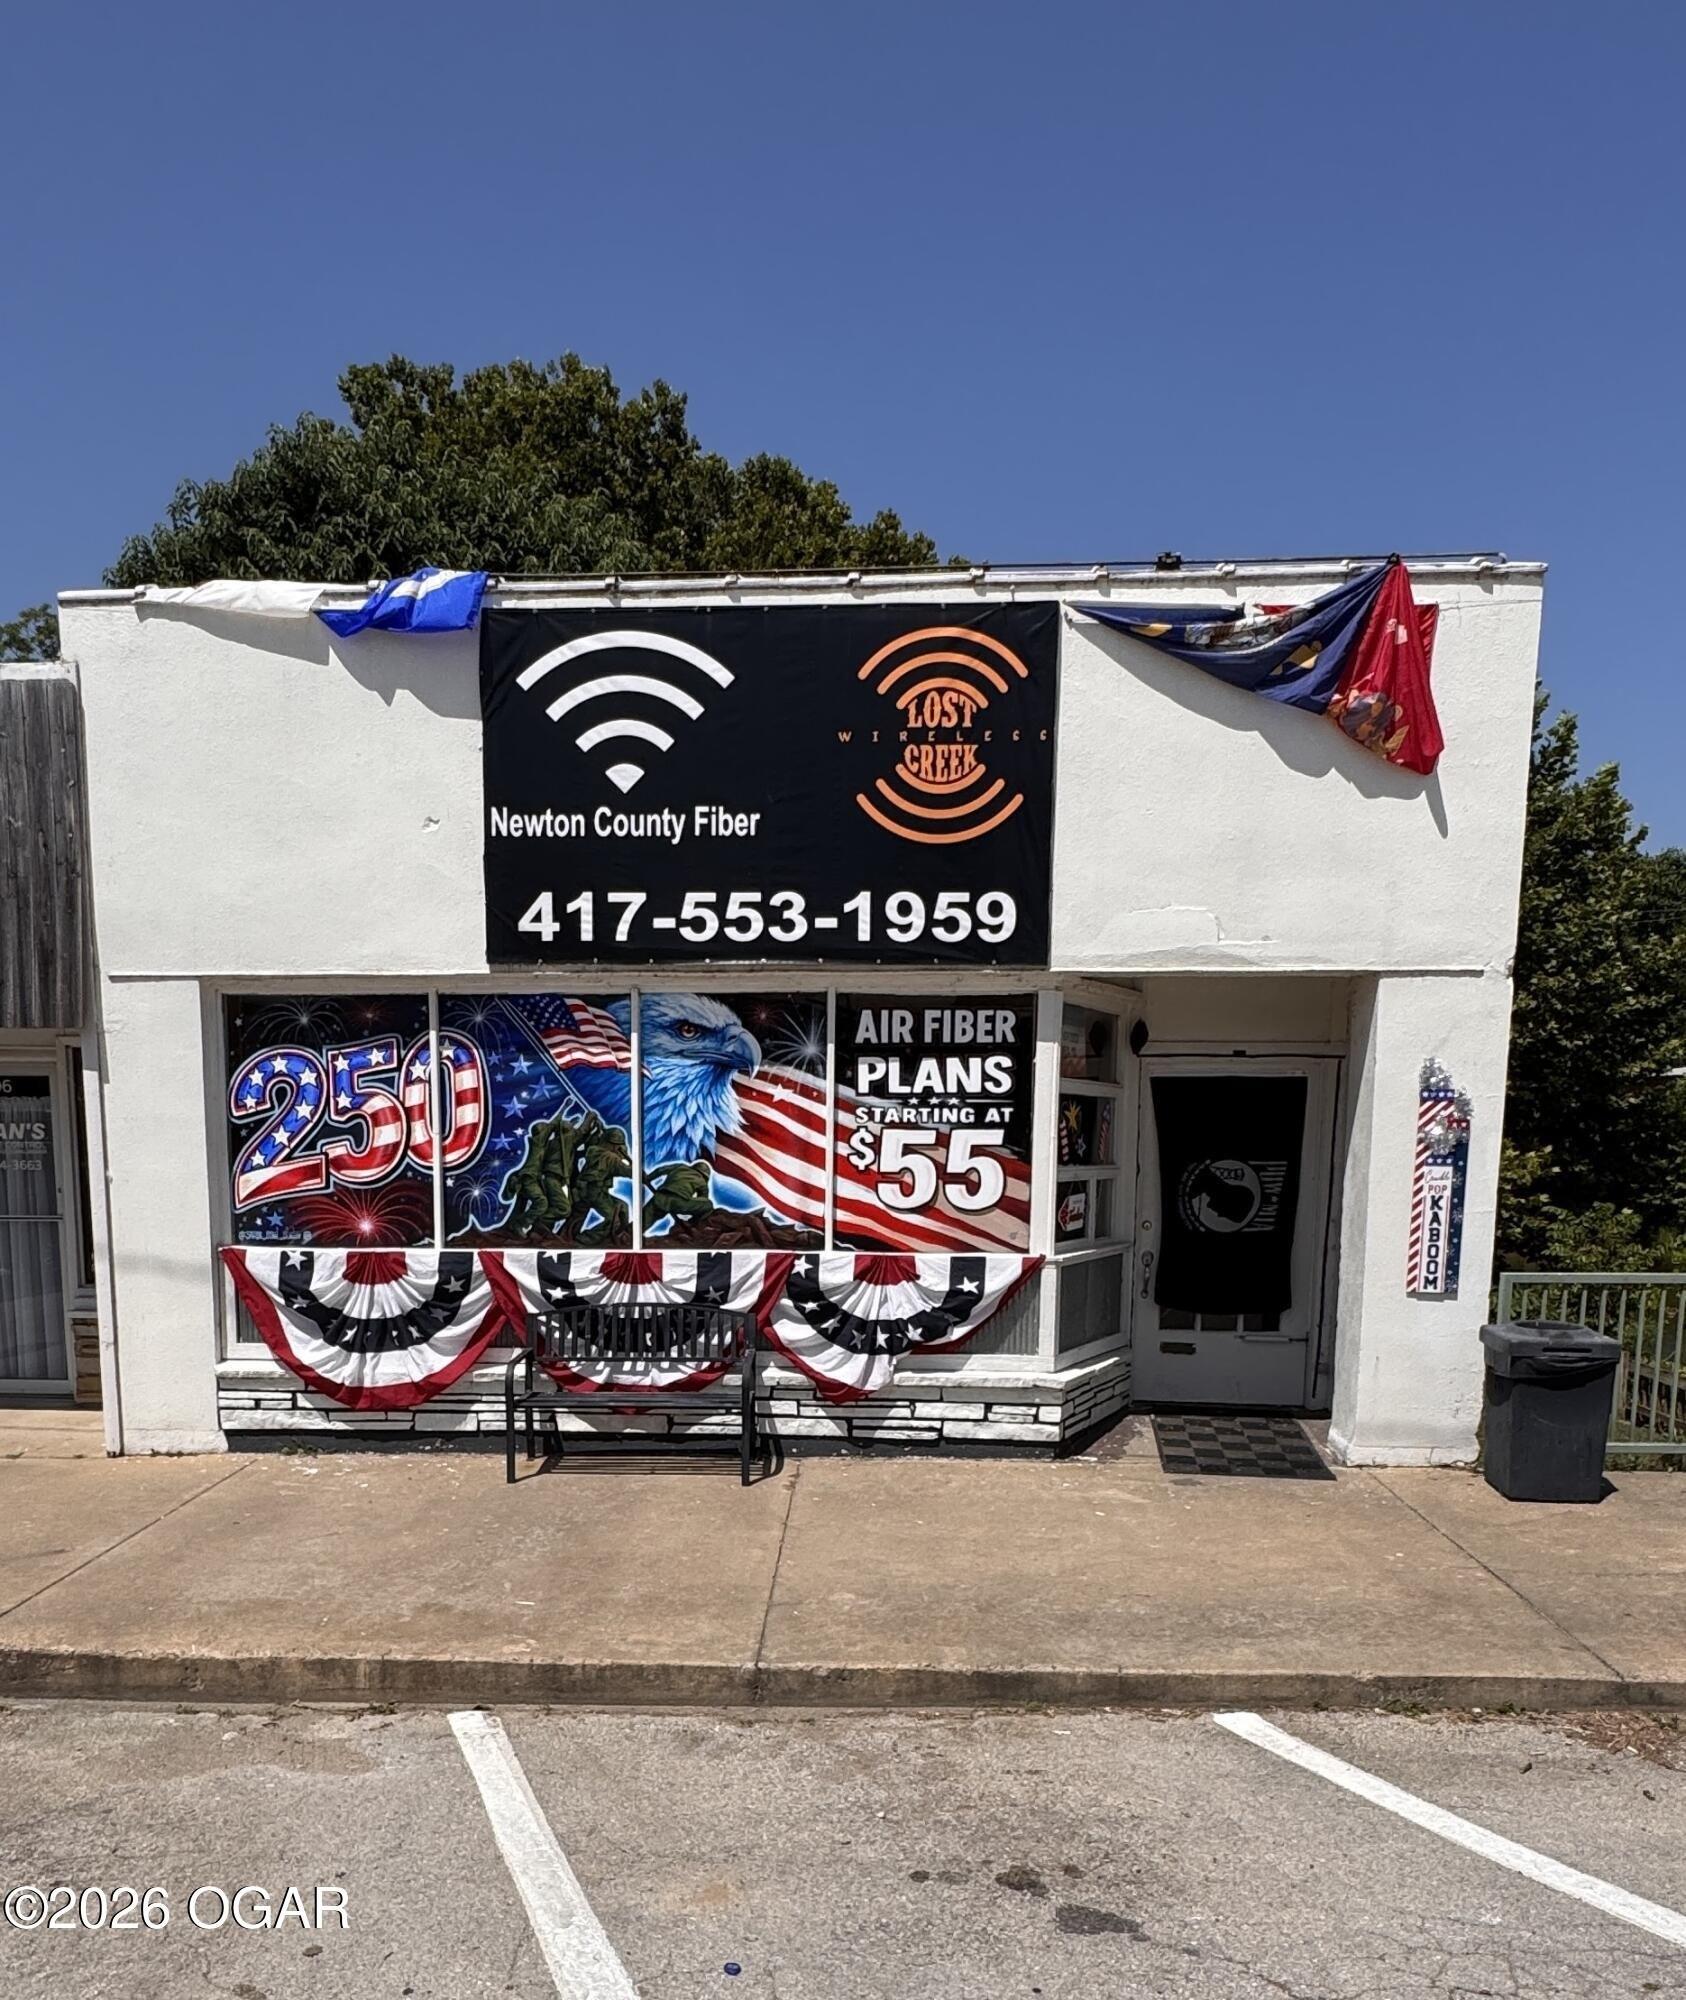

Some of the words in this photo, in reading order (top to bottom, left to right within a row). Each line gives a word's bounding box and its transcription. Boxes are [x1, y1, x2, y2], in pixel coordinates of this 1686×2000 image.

[907, 690, 977, 728] LOST
[837, 730, 1048, 743] WIRELESS
[903, 743, 979, 783] CREEK
[491, 806, 586, 838] Newton
[593, 806, 687, 845] County
[694, 806, 761, 838] Fiber
[517, 890, 1018, 944] 417-553-1959
[854, 1009, 915, 1044] AIR
[923, 1009, 1017, 1044] FIBER
[0, 1079, 13, 1093] 6
[857, 1055, 1014, 1095] PLANS
[228, 1027, 492, 1213] 250
[855, 1107, 976, 1124] STARTING
[984, 1107, 1015, 1123] AT
[848, 1127, 1006, 1212] $55
[1427, 1184, 1448, 1195] POP
[1423, 1195, 1444, 1290] KABOOM
